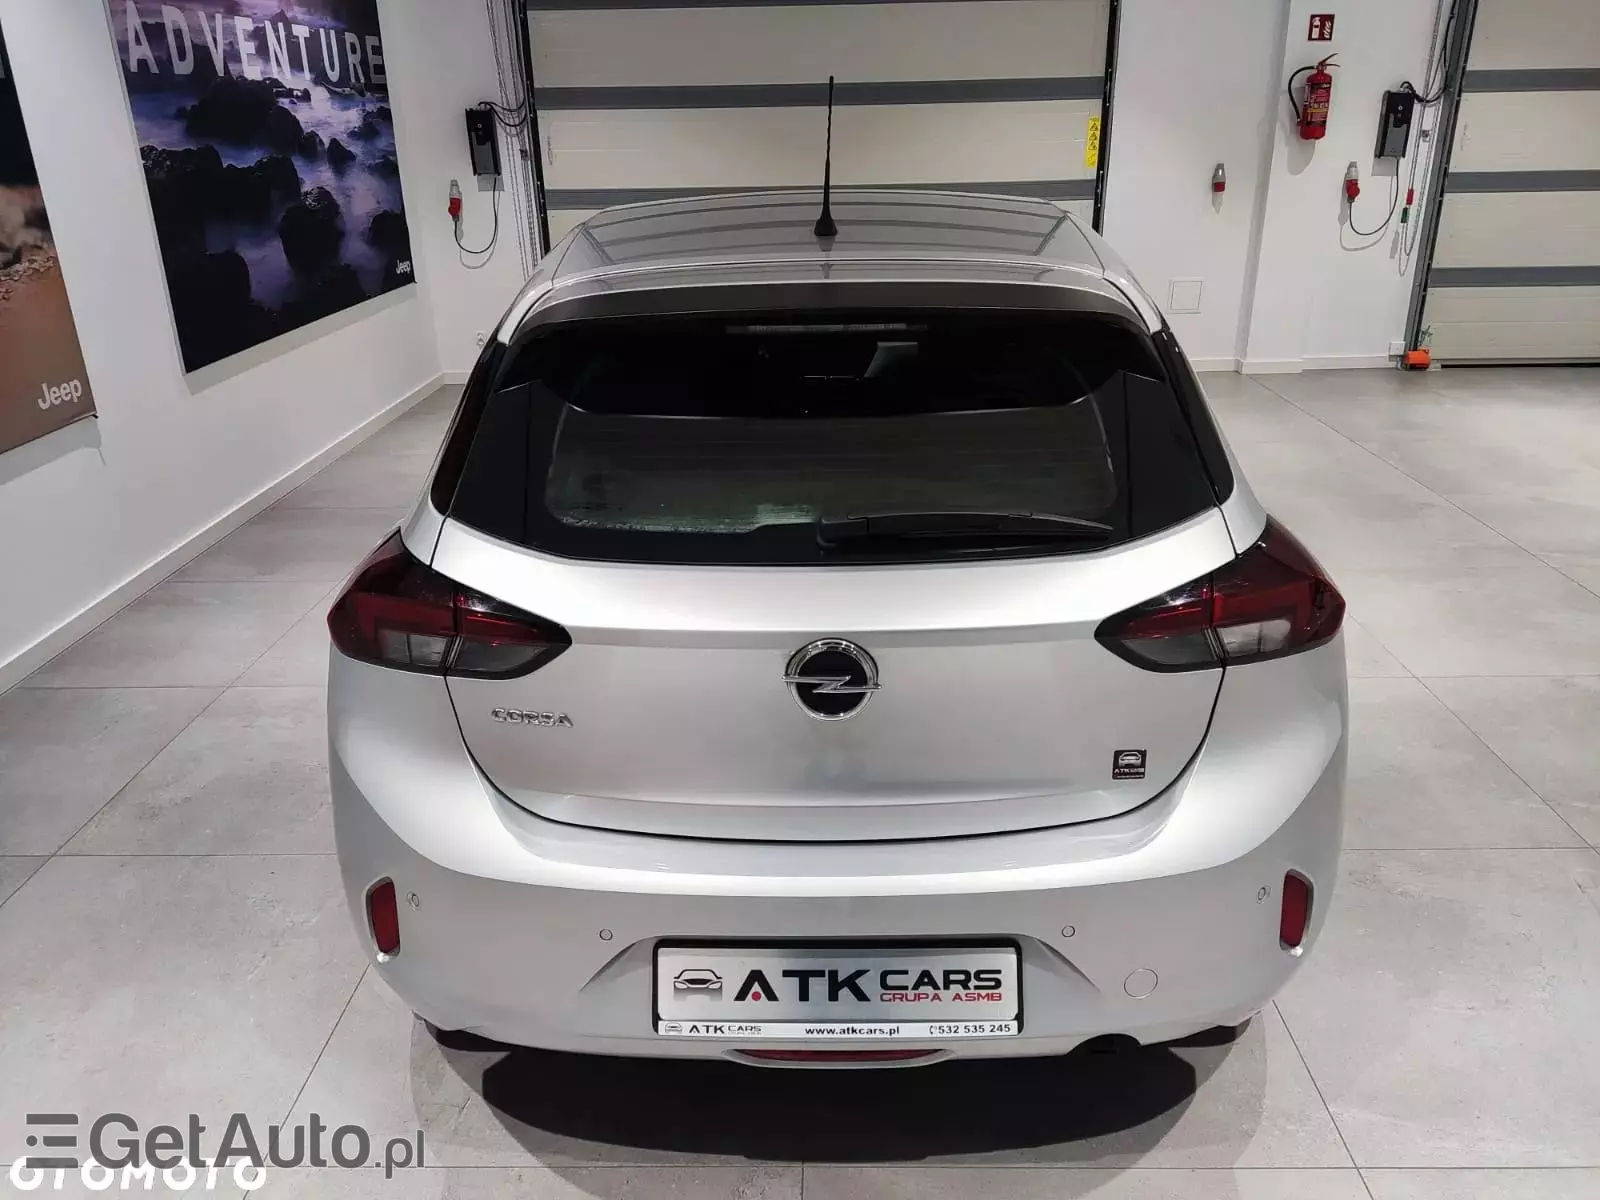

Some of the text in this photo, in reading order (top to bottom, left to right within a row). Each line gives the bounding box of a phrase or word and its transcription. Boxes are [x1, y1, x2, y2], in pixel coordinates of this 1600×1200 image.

[126, 0, 386, 85] ADVENTURE
[395, 259, 411, 274] Jeep
[37, 379, 82, 410] Jeep
[491, 708, 574, 728] CORSA
[733, 968, 1002, 1003] ATK CARS
[880, 992, 1002, 1003] GRUPA ASMB
[688, 1024, 725, 1034] ATK
[804, 1025, 900, 1036] www.atkcars.pl
[938, 1025, 960, 1034] 532
[963, 1024, 985, 1033] 535
[989, 1023, 1011, 1033] 245
